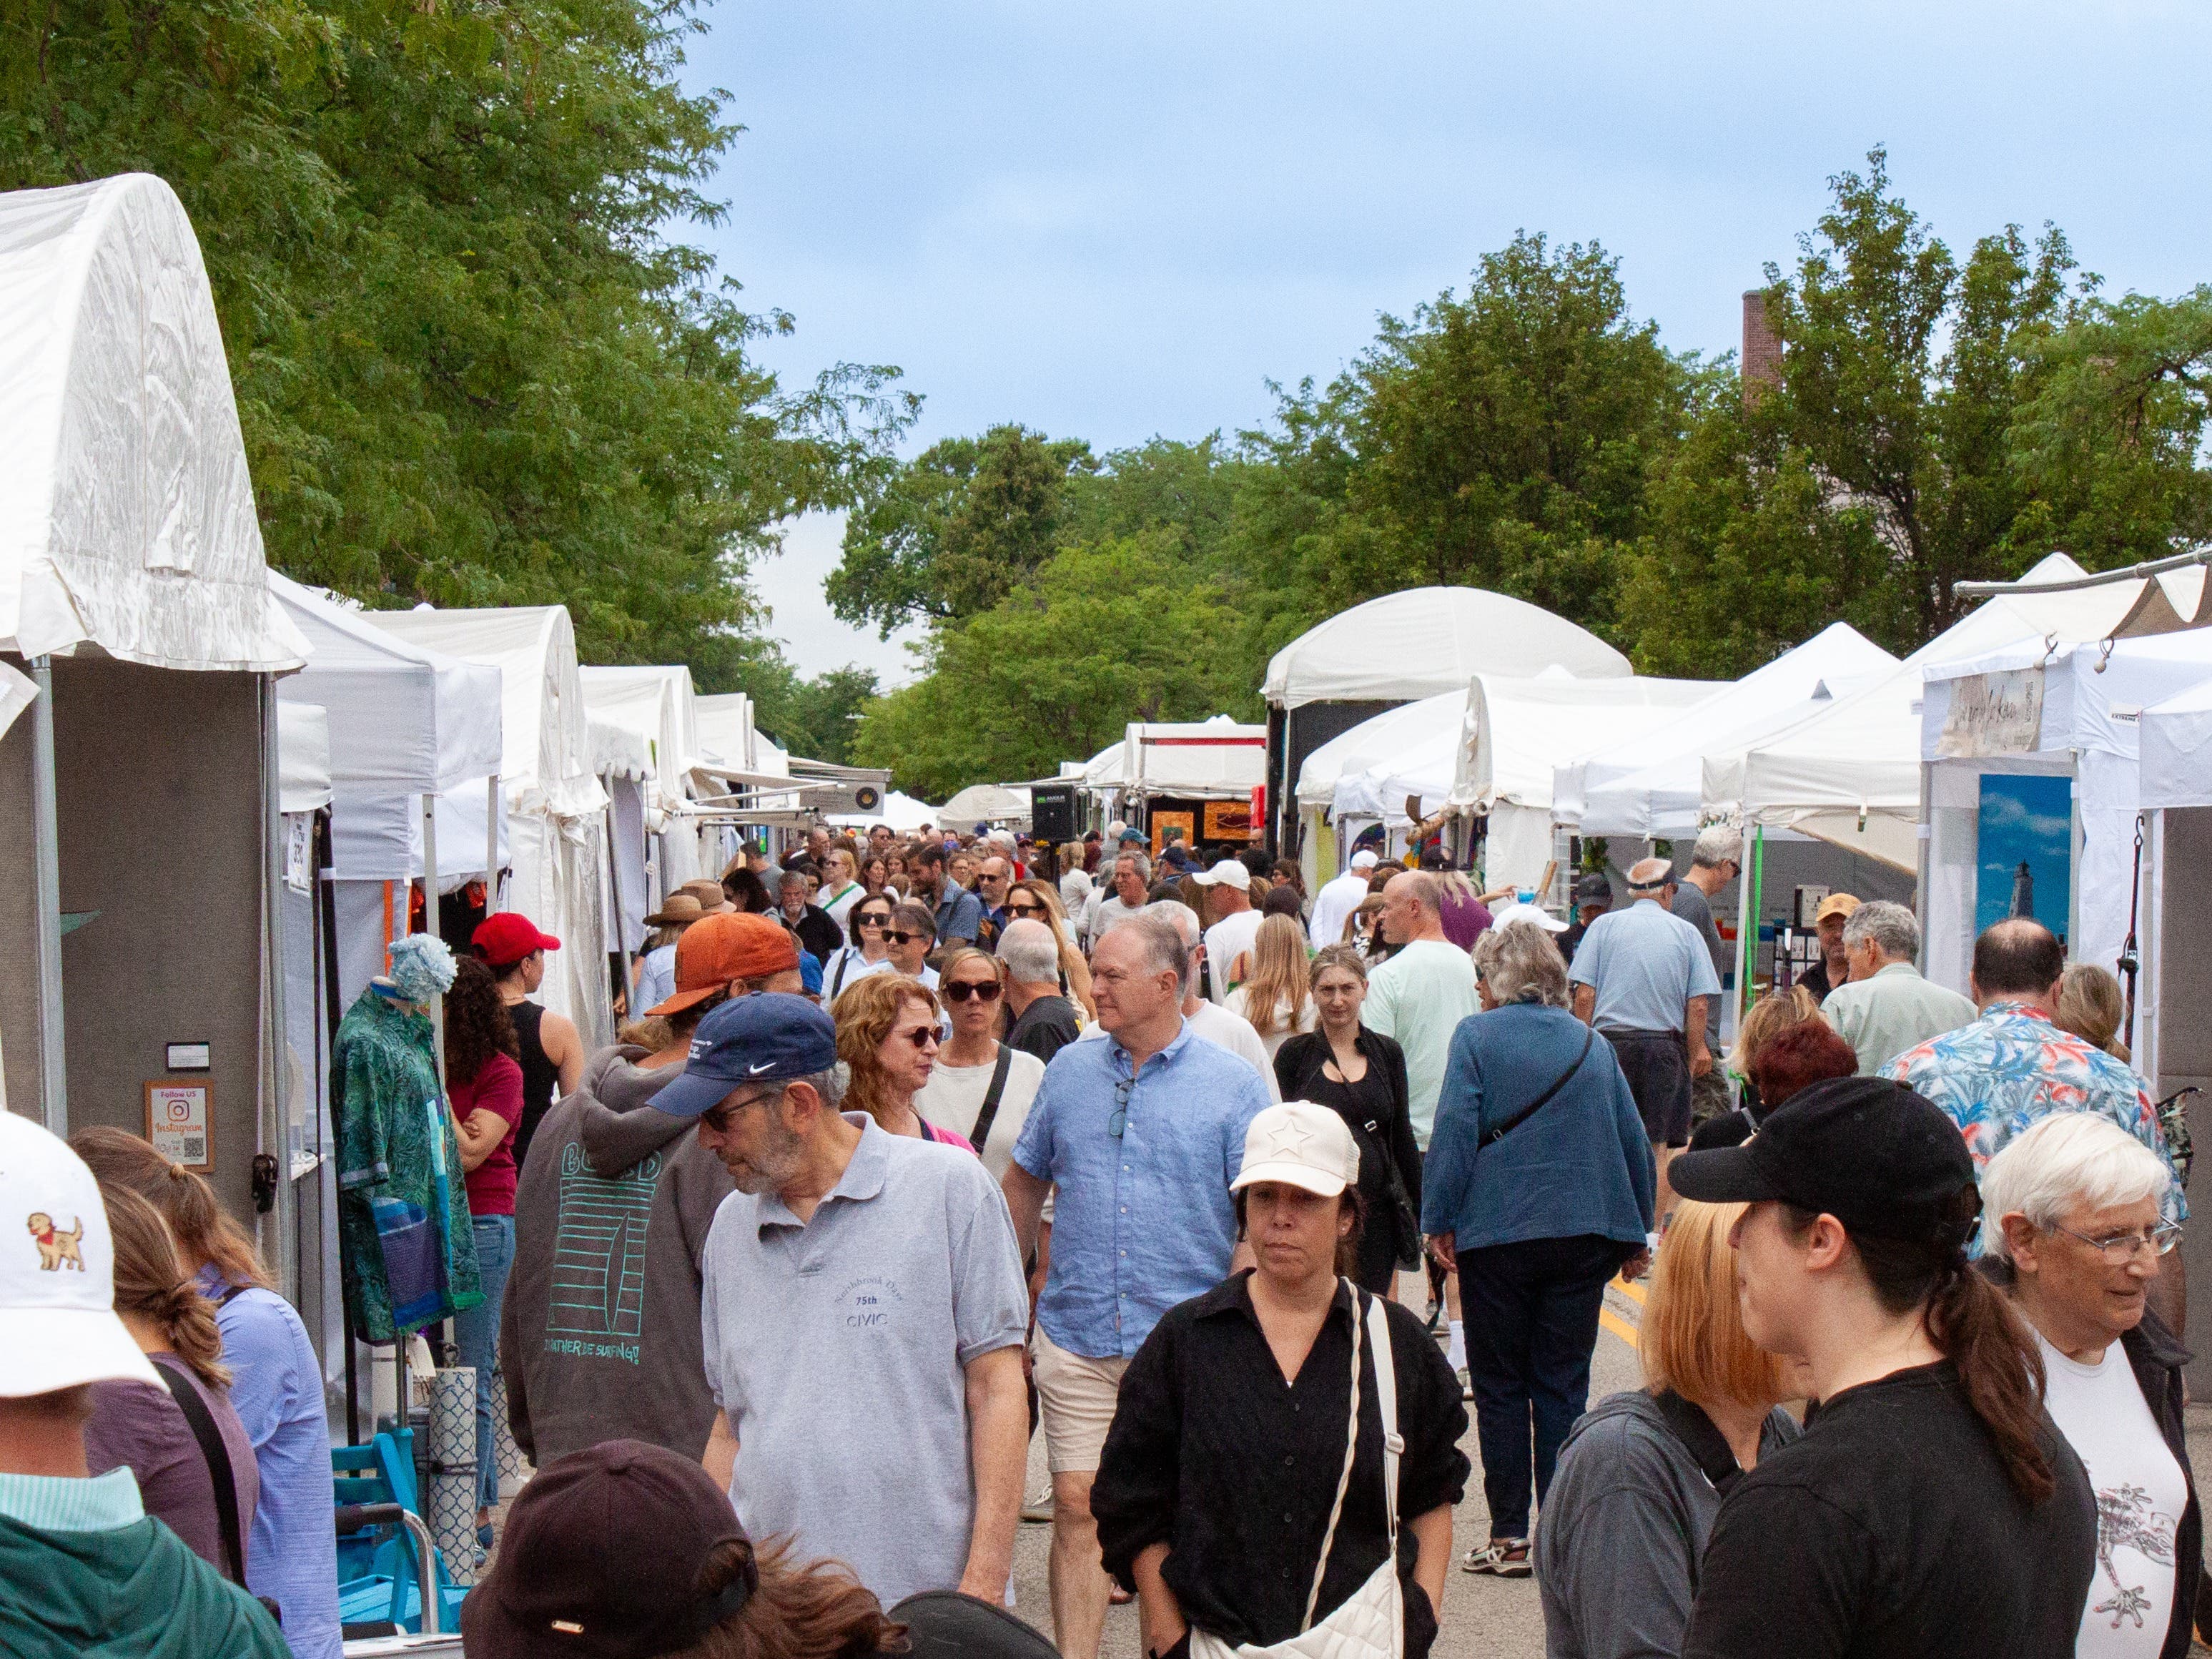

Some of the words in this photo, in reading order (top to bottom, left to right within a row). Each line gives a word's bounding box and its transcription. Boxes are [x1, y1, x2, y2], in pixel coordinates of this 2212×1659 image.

[155, 1122, 203, 1136] Instagram
[834, 1276, 882, 1304] Northbrook
[856, 1295, 877, 1306] 75th
[846, 1313, 888, 1327] CIVIC
[551, 1339, 581, 1357] ATHER
